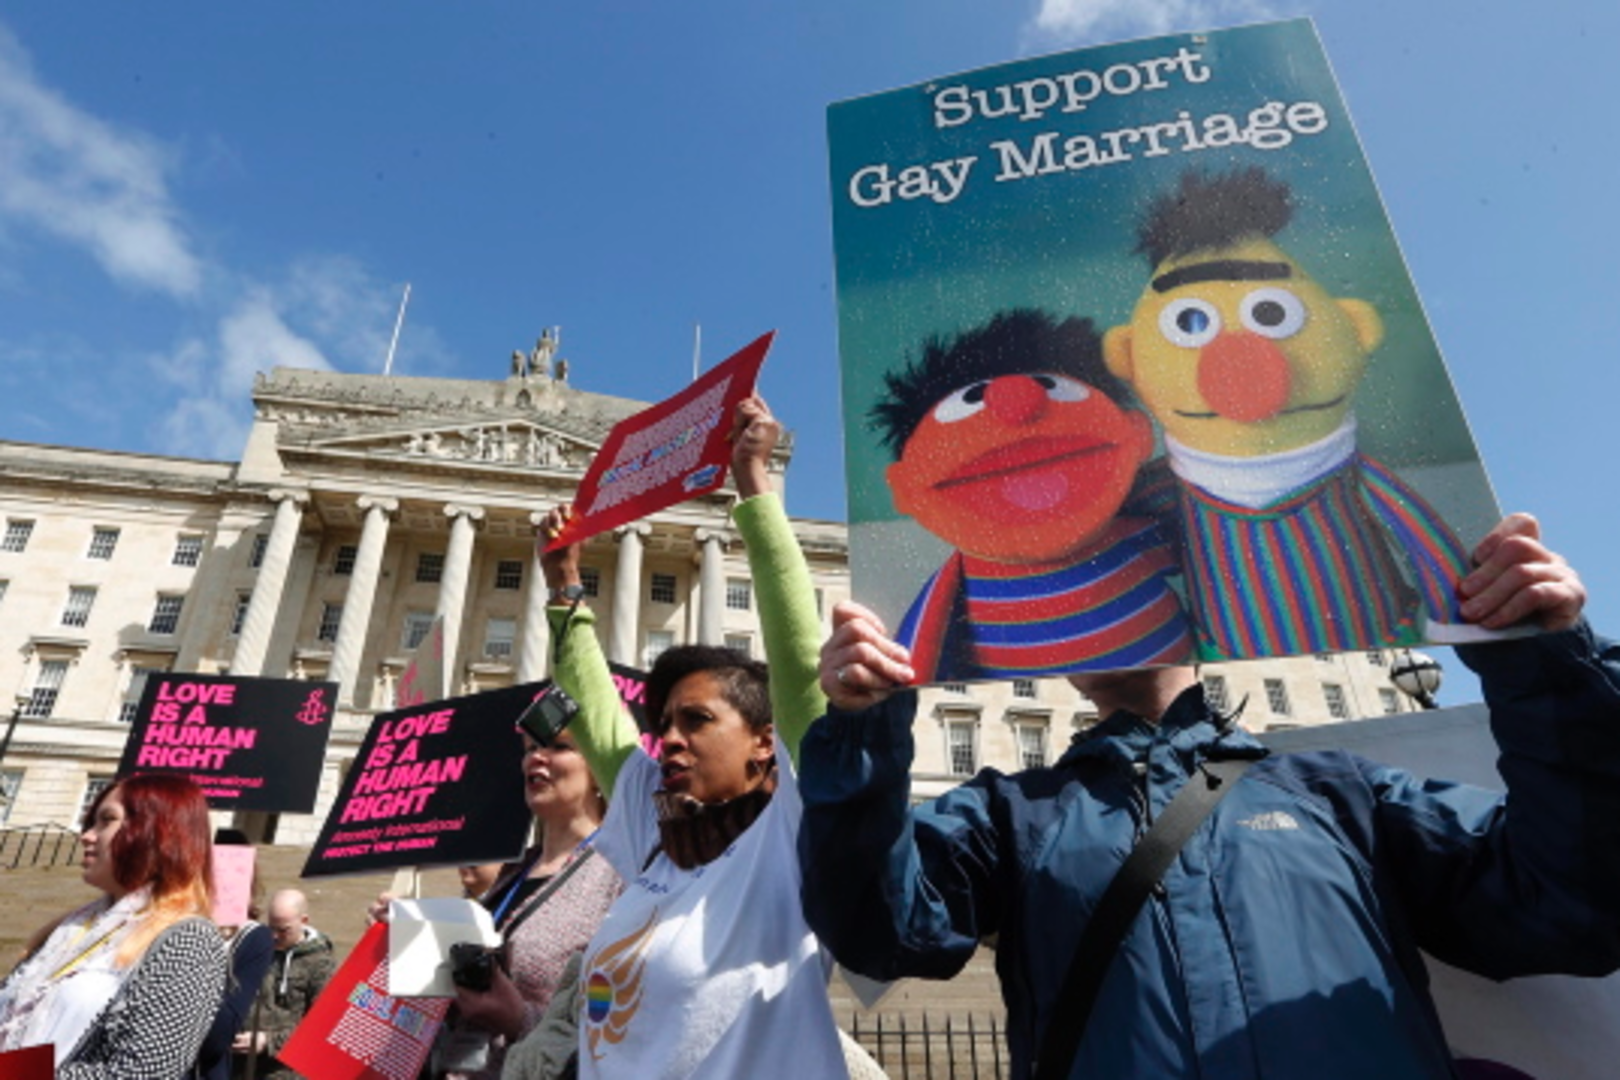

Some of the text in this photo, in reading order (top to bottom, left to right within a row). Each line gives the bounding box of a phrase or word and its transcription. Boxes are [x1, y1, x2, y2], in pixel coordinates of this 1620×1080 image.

[934, 46, 1211, 128] Support
[848, 99, 1328, 207] Gay Marriage
[157, 682, 235, 704] LOVE
[150, 702, 206, 725] IS A
[377, 708, 456, 744] LOVE
[144, 724, 256, 748] HUMAN
[137, 746, 231, 769] RIGHT
[363, 739, 420, 770] IS A
[352, 754, 468, 796] HUMAN
[339, 786, 437, 824] RIGHT
